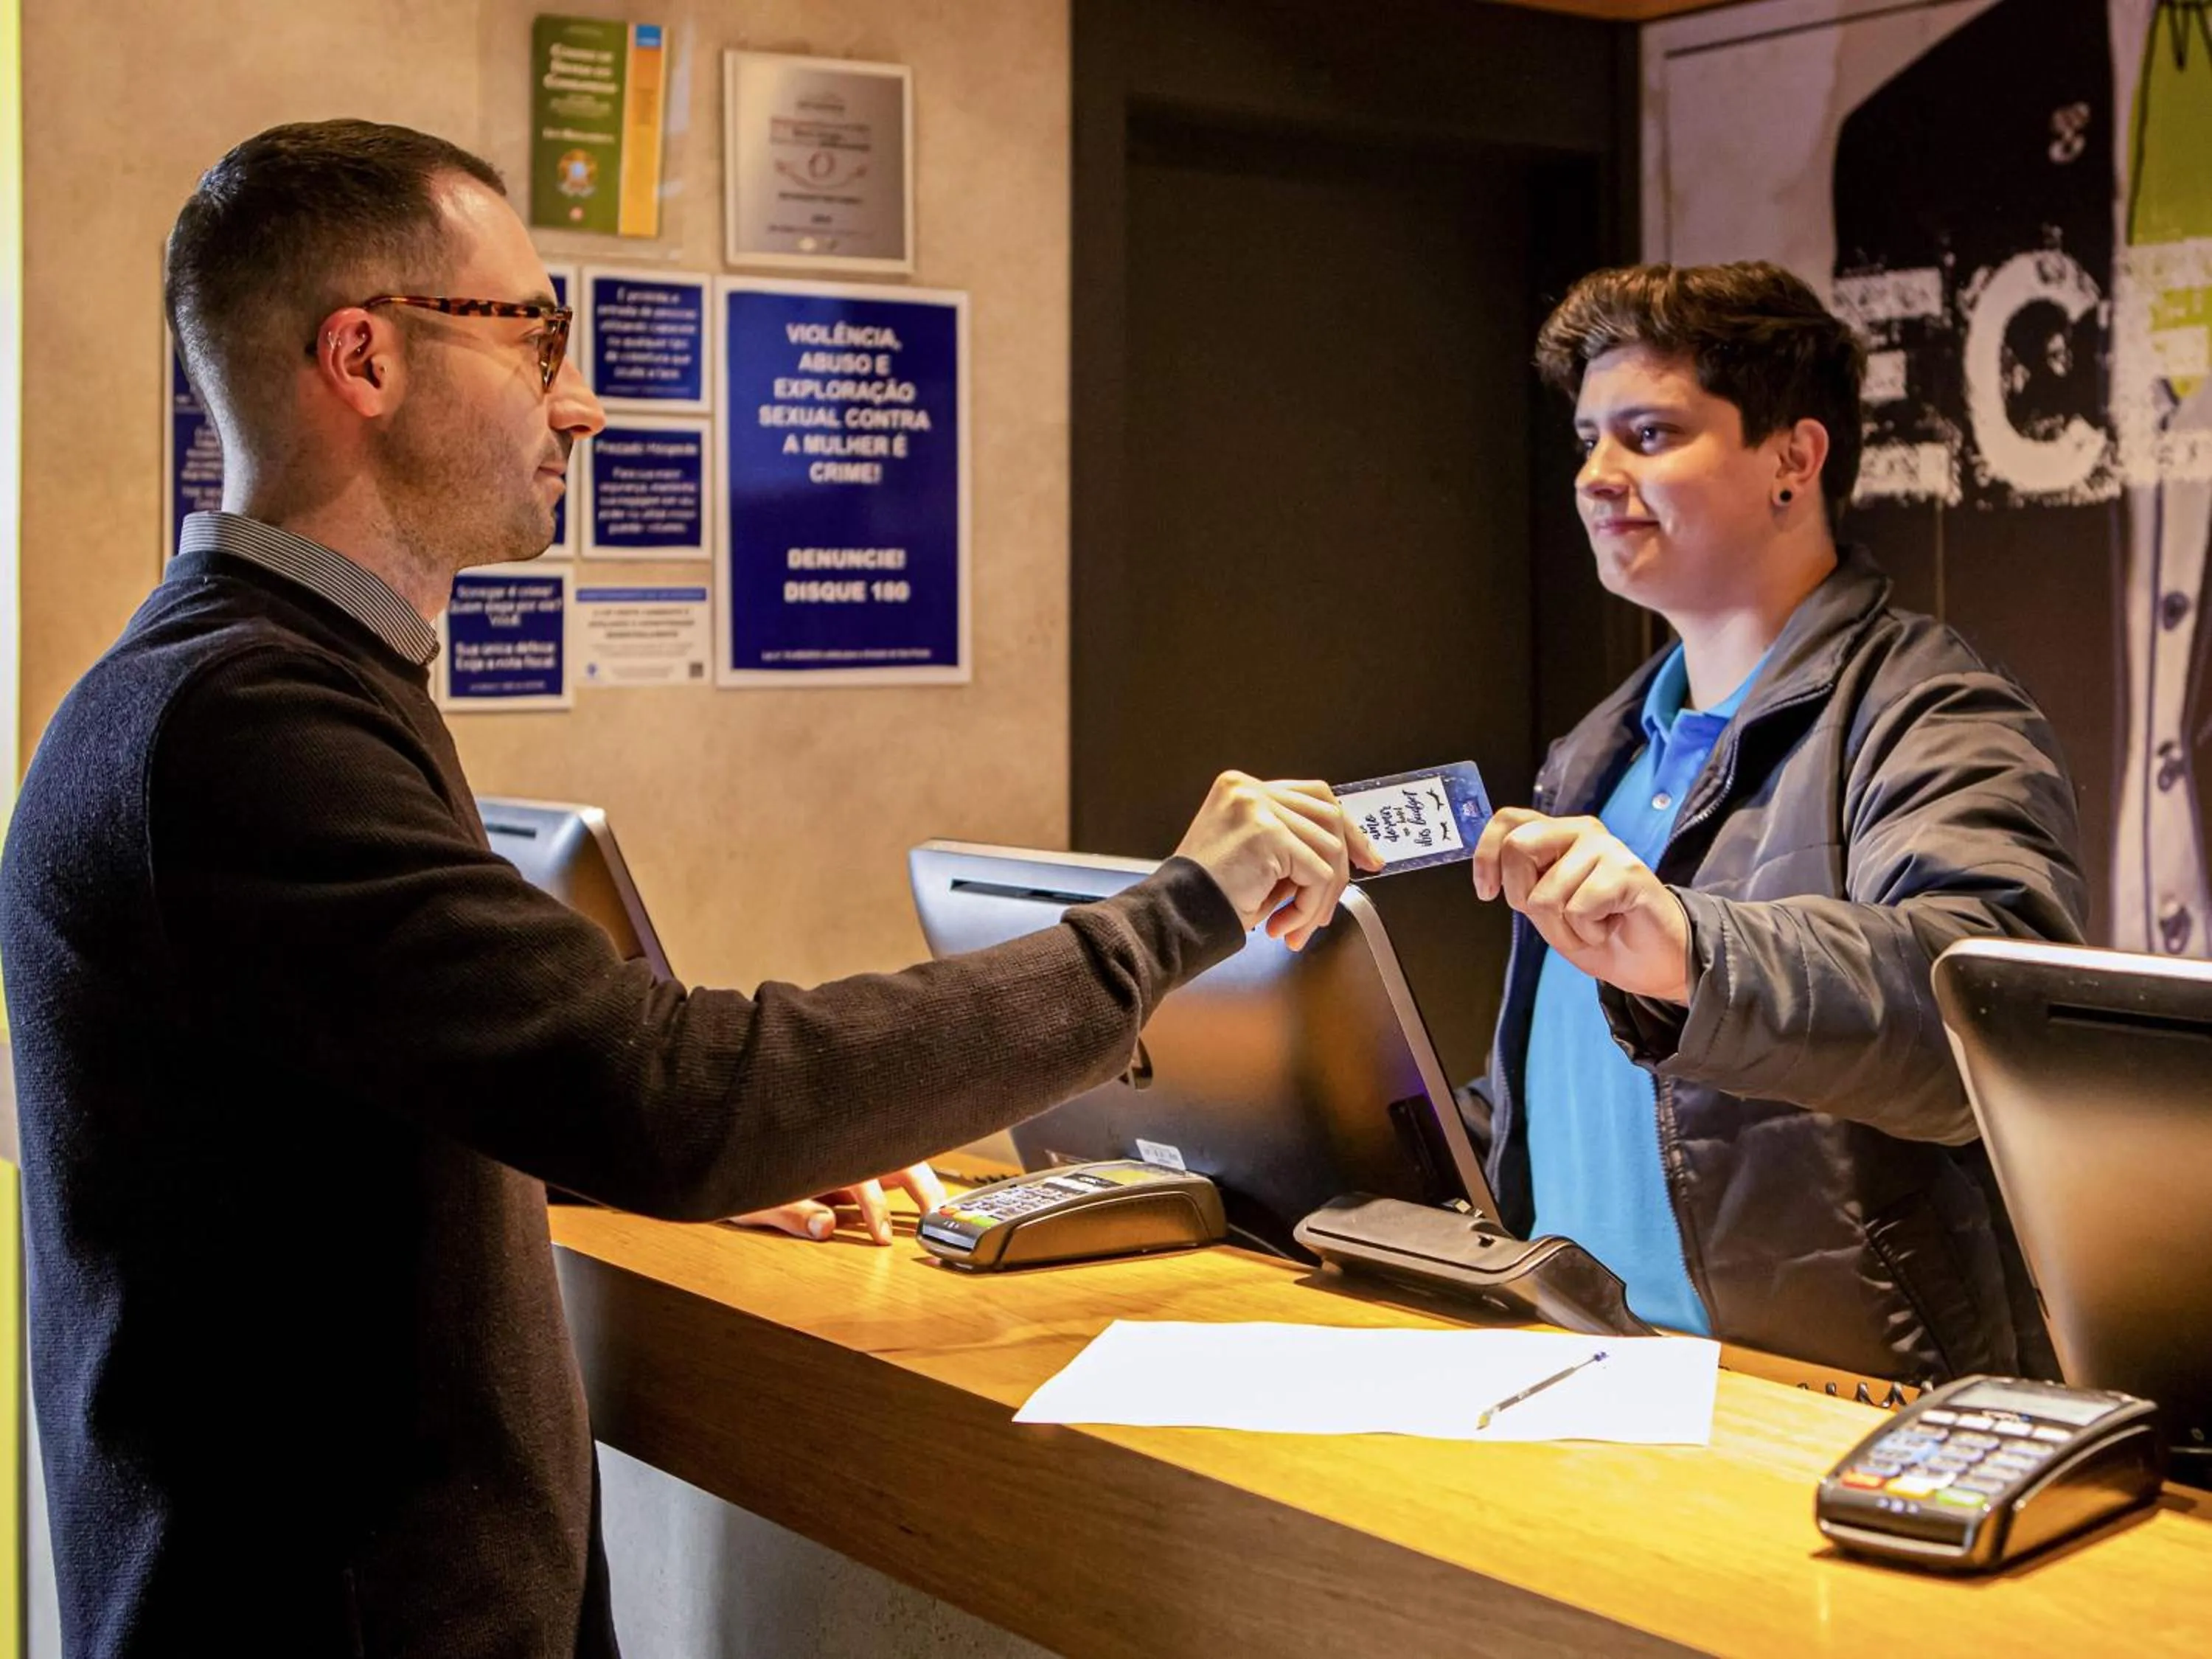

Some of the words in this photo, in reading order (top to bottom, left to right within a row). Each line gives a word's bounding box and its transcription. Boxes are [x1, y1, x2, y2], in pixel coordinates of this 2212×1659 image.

[785, 321, 902, 351] VIOLÊNCIA,
[798, 352, 870, 375] ABUSO
[874, 355, 890, 375] E
[773, 377, 916, 405] EXPLORAÇÃO
[759, 405, 840, 428] SEXUAL
[844, 407, 931, 431] CONTRA
[782, 434, 800, 454] A
[803, 434, 888, 456] MULHER
[892, 431, 908, 458] É
[809, 462, 882, 484] CRIME!
[787, 548, 906, 570] DENUNCIE!
[784, 581, 866, 603] DISQUE
[1401, 790, 1427, 826] budget
[1365, 813, 1382, 841] amo
[1413, 827, 1433, 847] ibis
